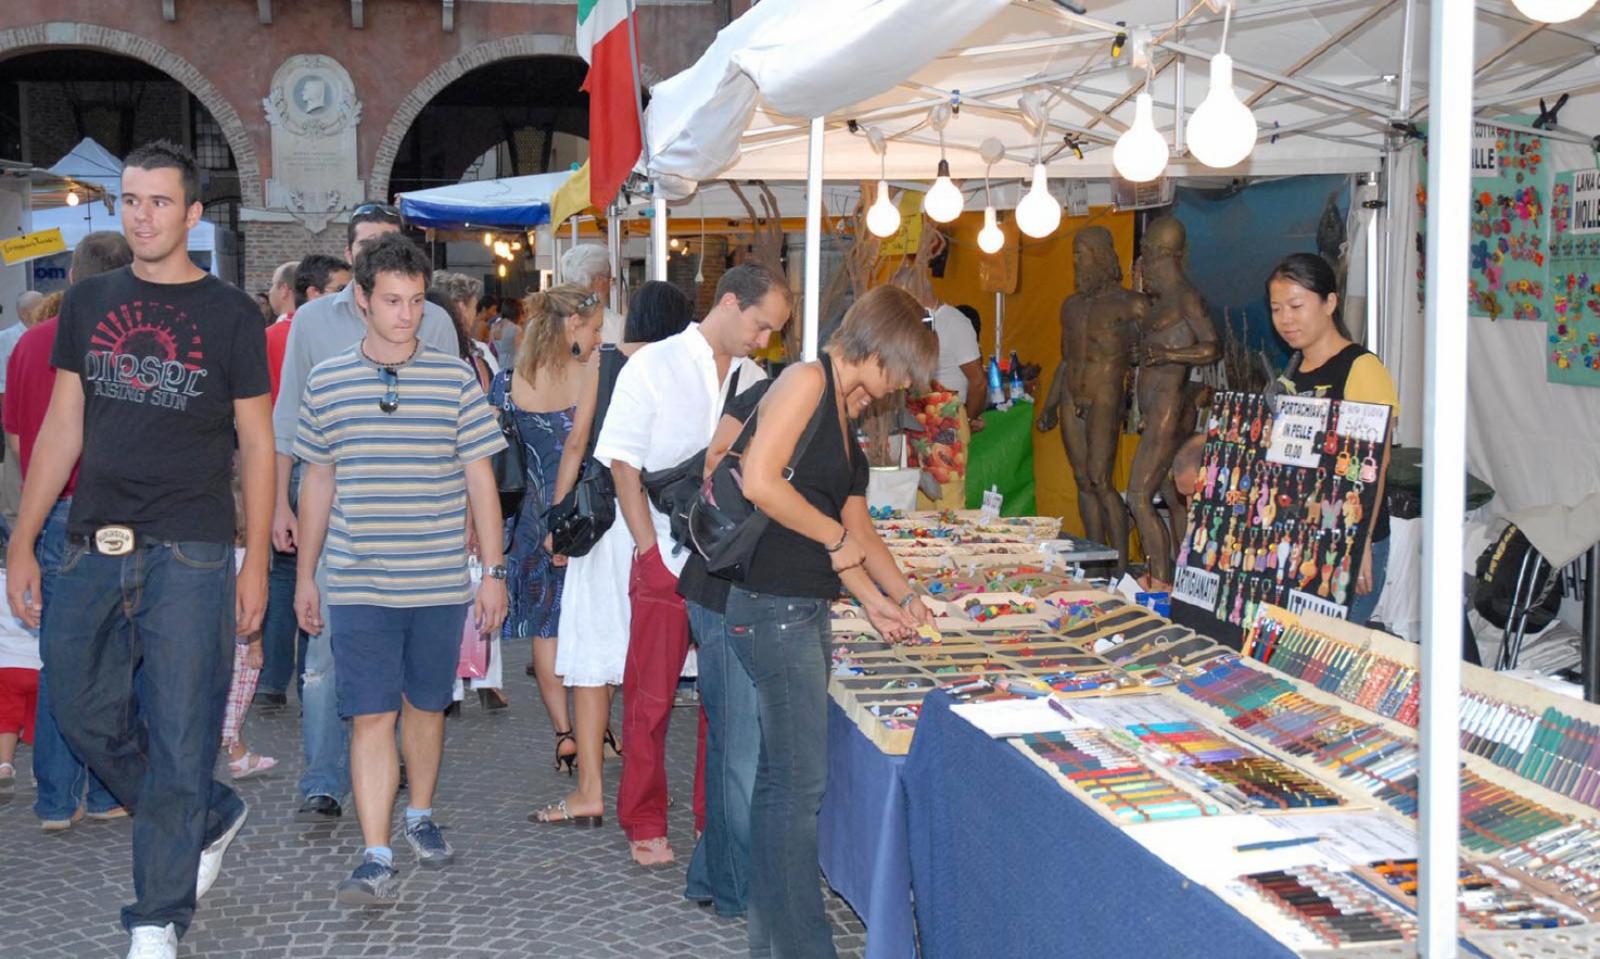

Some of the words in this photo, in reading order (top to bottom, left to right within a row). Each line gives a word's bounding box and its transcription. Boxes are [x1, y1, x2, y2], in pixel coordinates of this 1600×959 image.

[1576, 172, 1596, 193] LANA
[150, 389, 189, 411] SUN
[1290, 424, 1313, 440] PELLE
[1175, 567, 1218, 604] ARTIGIANATO
